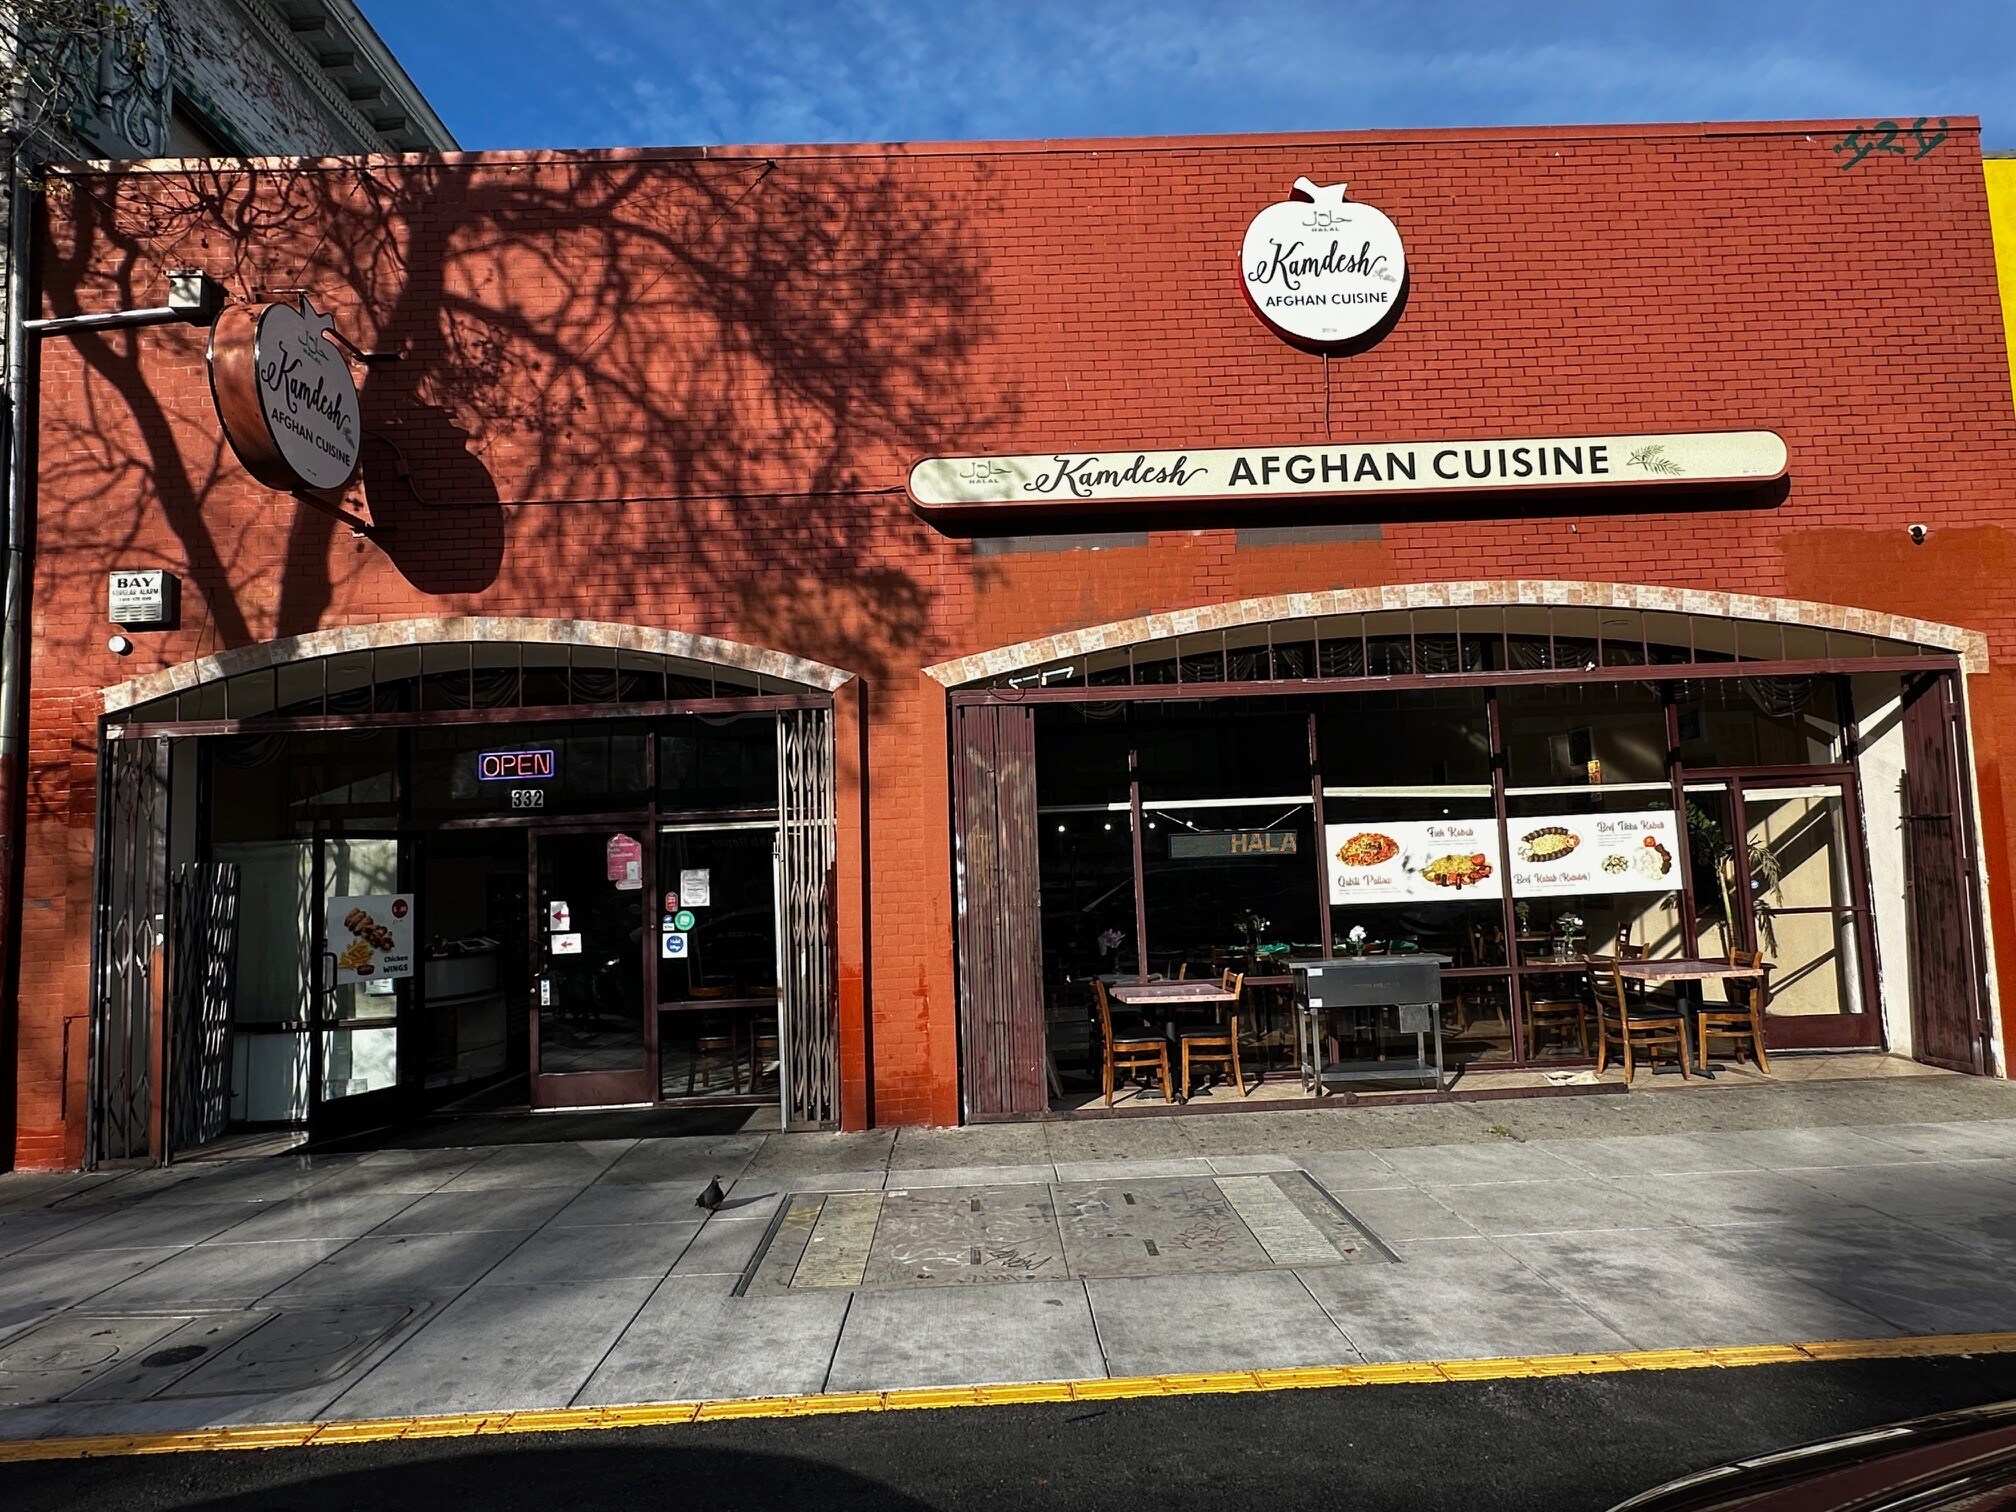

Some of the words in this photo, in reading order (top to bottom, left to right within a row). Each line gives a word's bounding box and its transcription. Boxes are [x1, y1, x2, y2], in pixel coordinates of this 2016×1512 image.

[1301, 210, 1353, 227] حلال
[1248, 238, 1386, 290] Kamdesh
[1265, 294, 1326, 307] AFGHAN
[1331, 292, 1388, 305] CUISINE
[260, 340, 351, 431] Kamdesh
[271, 407, 313, 445] AFGHAN
[315, 436, 351, 467] CUISINE
[959, 461, 1013, 479] حلال
[1023, 455, 1208, 497] Kamdesh
[1228, 451, 1416, 486] AFGHAN
[1432, 445, 1610, 479] CUISINE
[117, 577, 154, 588] BAY
[483, 753, 550, 777] OPEN
[513, 790, 543, 807] 332
[1597, 821, 1614, 834] Beef
[1230, 832, 1297, 853] HALA
[384, 955, 408, 963] Chicken
[383, 964, 408, 973] WINGS
